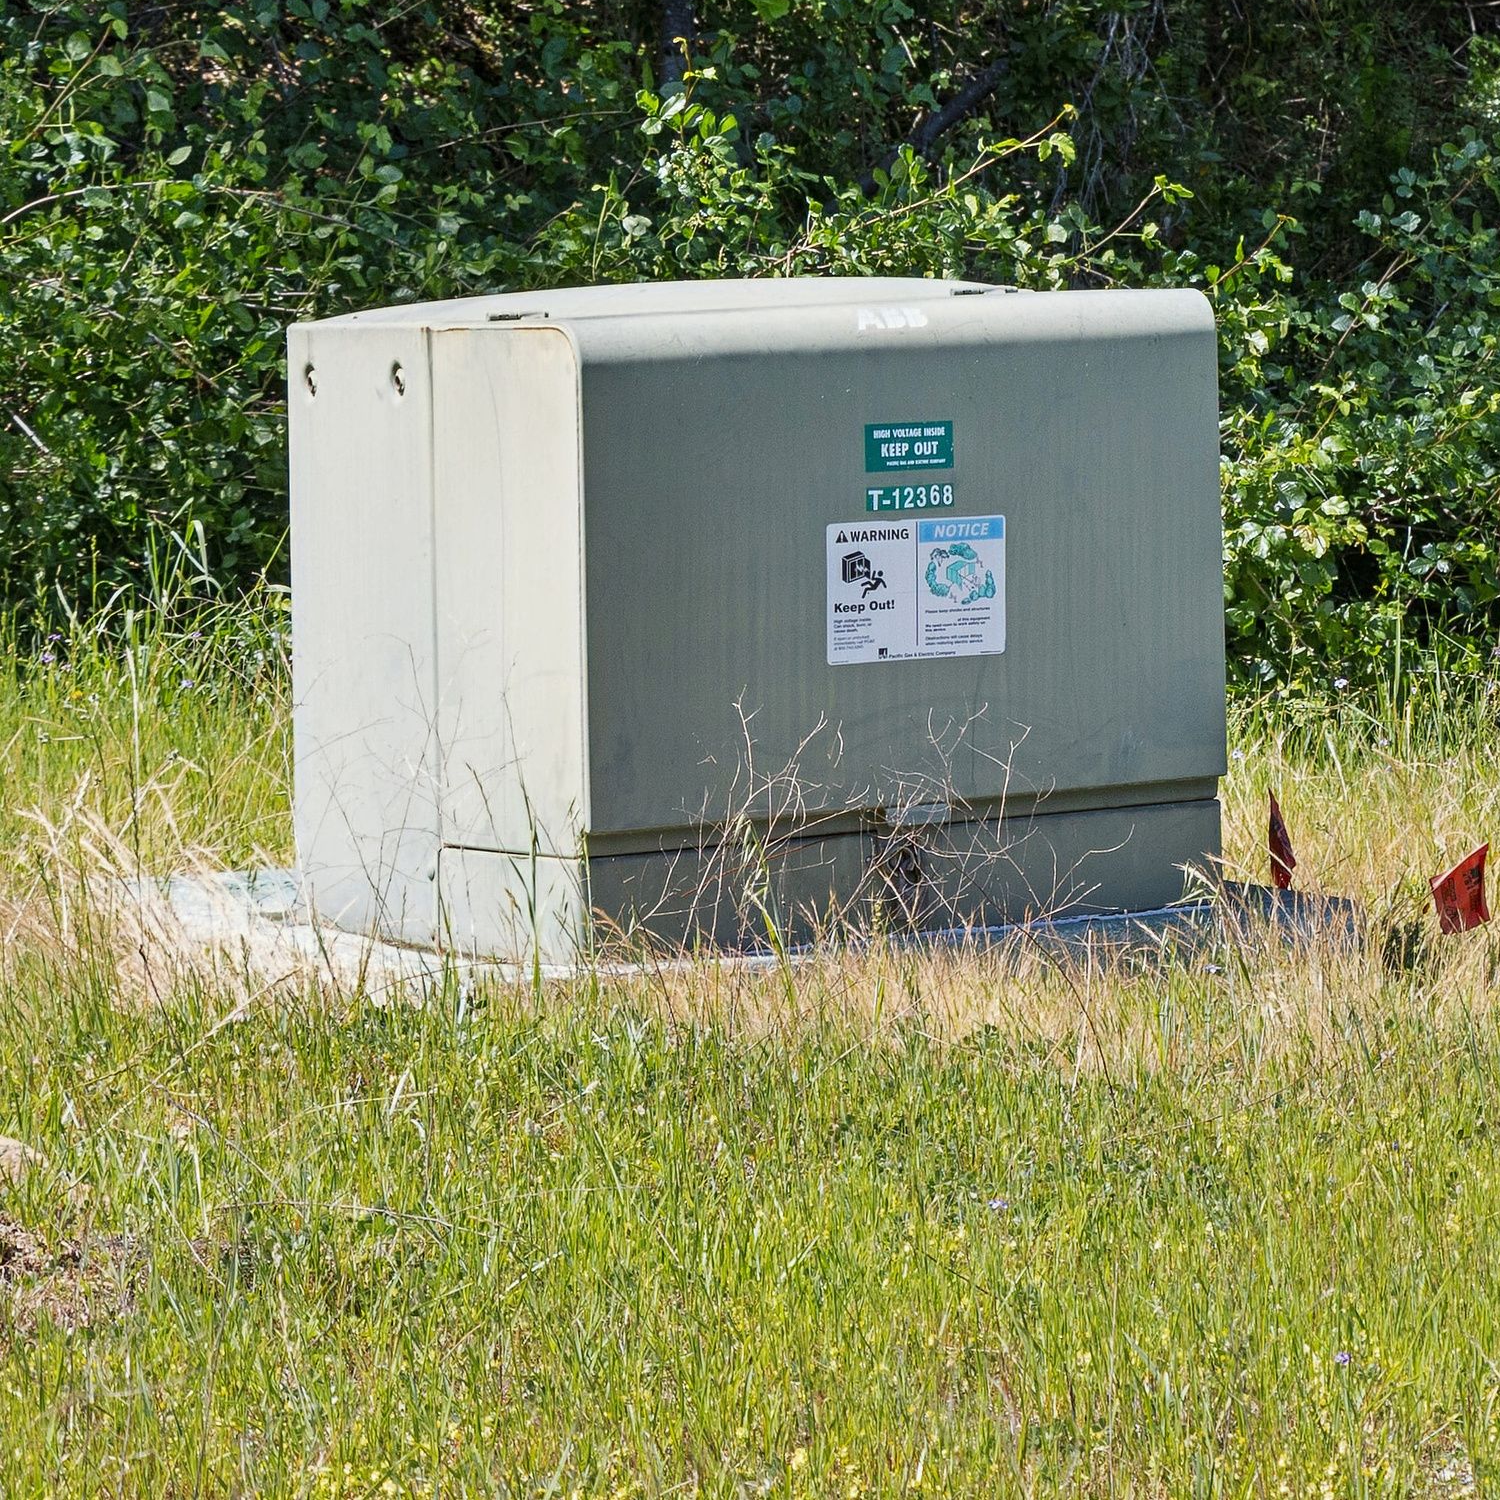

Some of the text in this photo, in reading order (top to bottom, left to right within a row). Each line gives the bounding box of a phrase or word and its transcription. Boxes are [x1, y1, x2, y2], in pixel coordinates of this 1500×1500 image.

[873, 427, 945, 439] HIGH VOLTAGE INSIDE
[881, 441, 938, 457] KEEP OUT
[868, 484, 953, 511] T-12368
[850, 528, 909, 542] WARNING
[934, 523, 990, 538] NOTICE
[834, 600, 895, 614] Keep Out!
